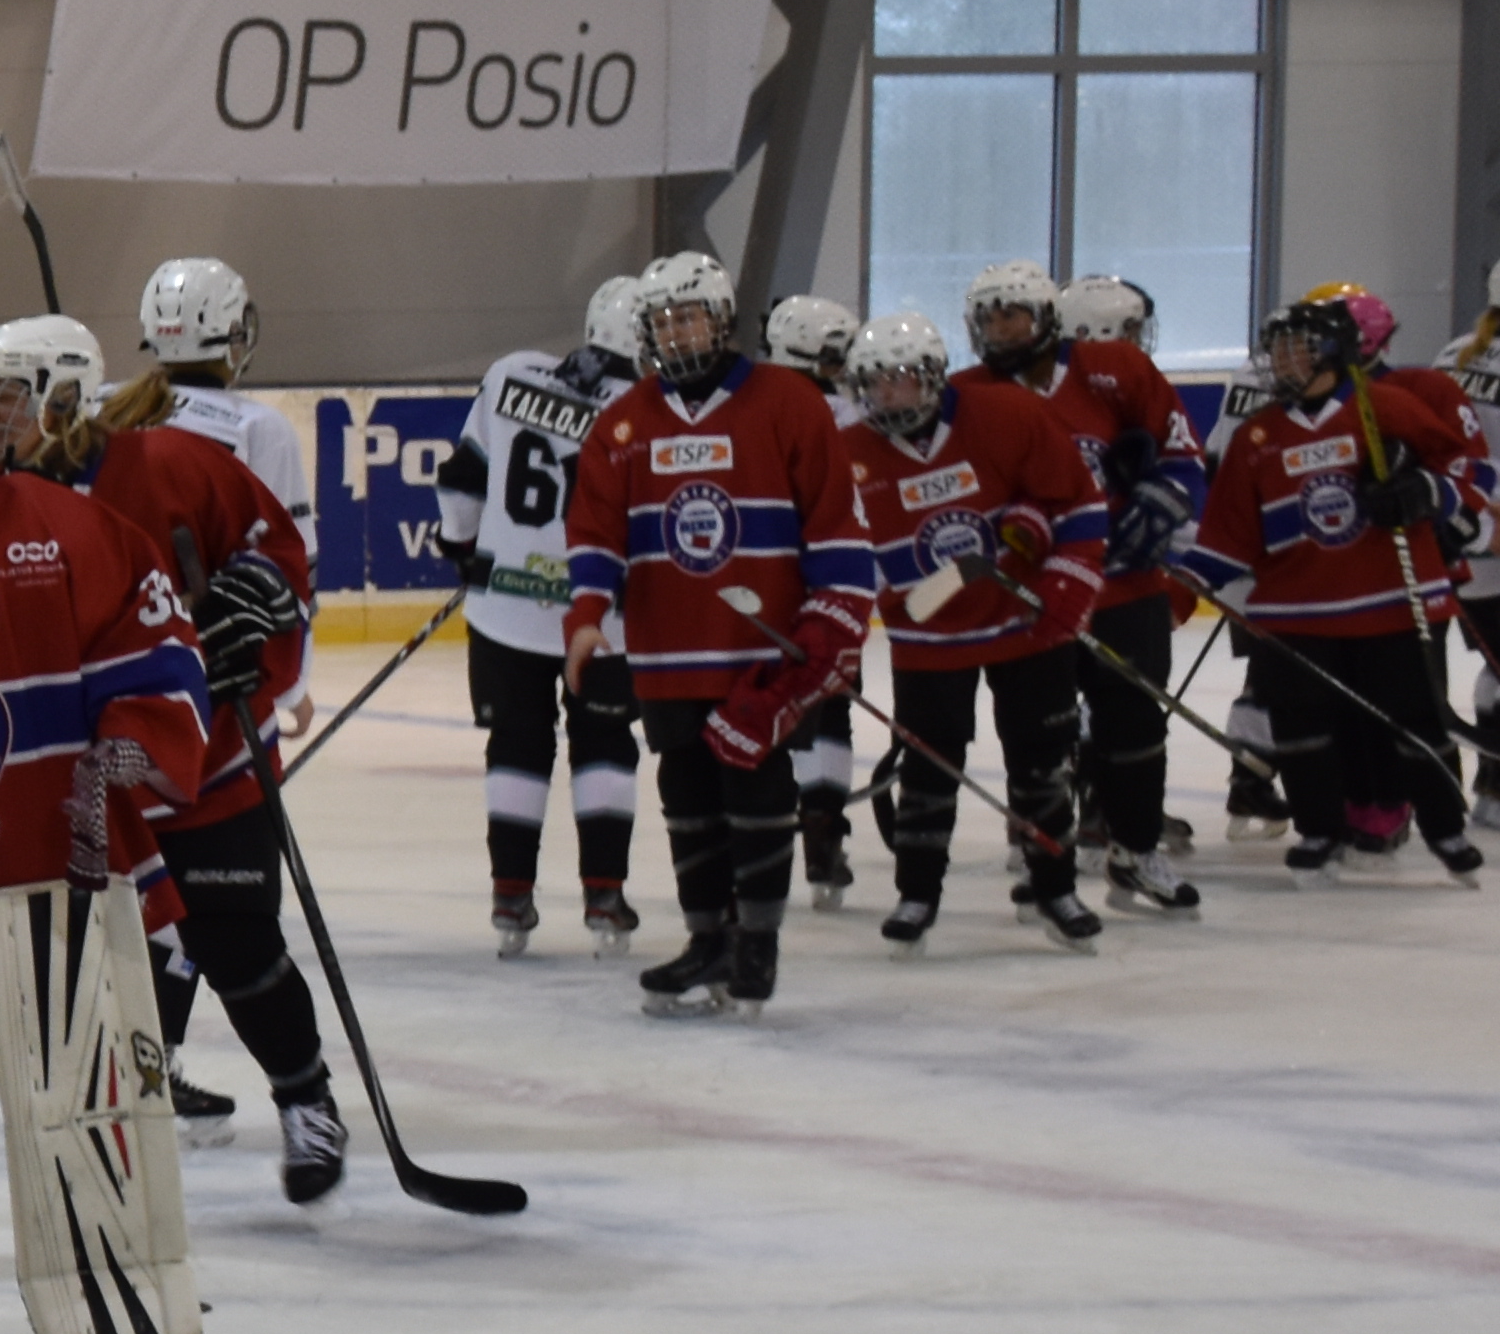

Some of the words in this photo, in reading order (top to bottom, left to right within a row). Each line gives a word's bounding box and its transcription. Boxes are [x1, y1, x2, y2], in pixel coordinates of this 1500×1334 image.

[215, 16, 367, 134] OP
[398, 21, 638, 134] Posio
[341, 424, 455, 496] Po
